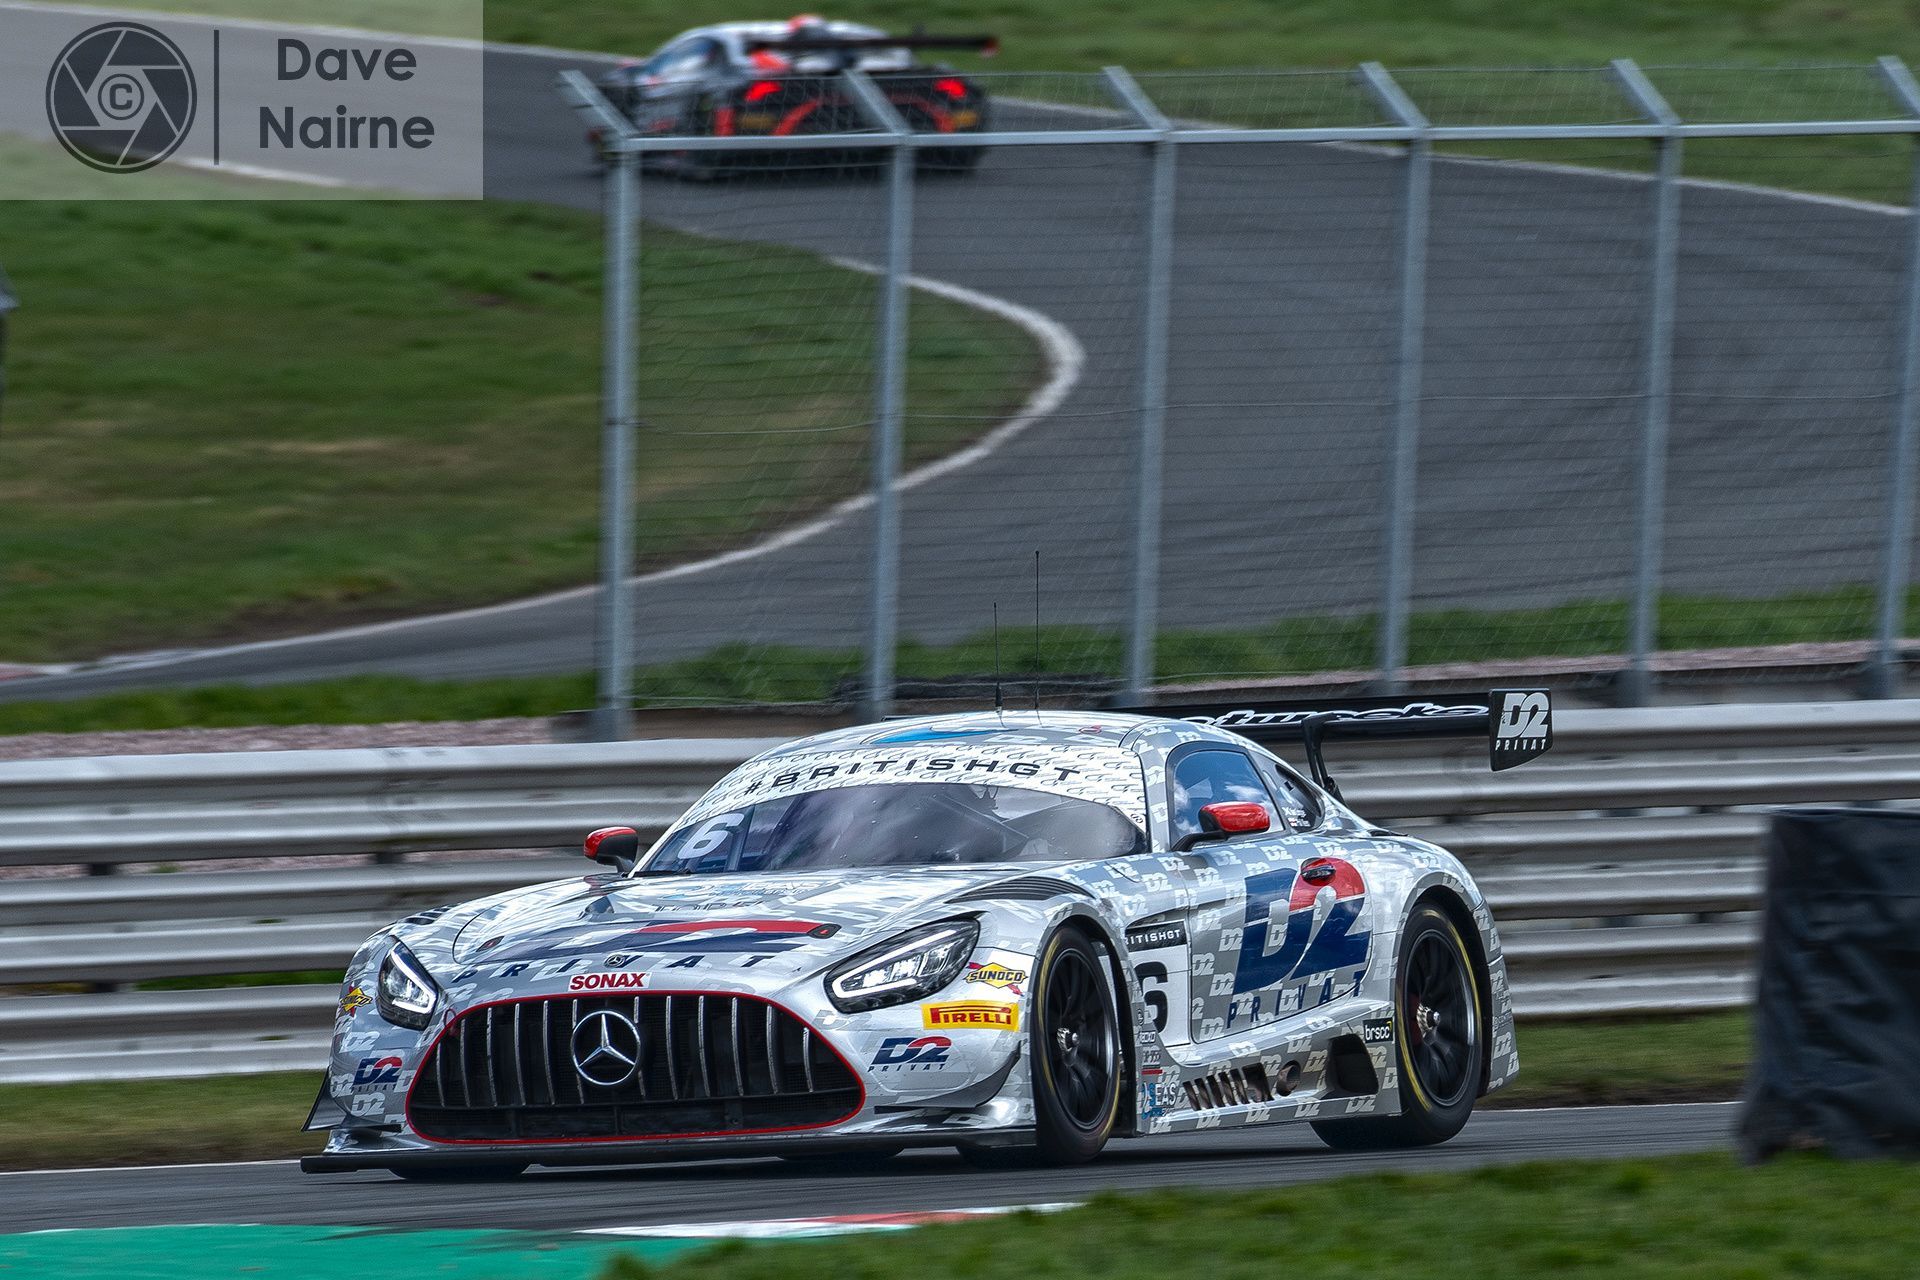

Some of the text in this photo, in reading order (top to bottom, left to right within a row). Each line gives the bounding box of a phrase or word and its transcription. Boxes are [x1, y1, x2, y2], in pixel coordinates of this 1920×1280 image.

[1497, 692, 1549, 738] D2
[1495, 739, 1546, 751] PRIVAT
[744, 758, 1080, 796] #BRITISHGT
[677, 813, 745, 860] 6
[1232, 857, 1373, 996] D2
[570, 973, 646, 990] SONAX
[969, 970, 1024, 983] SUNOCO
[929, 1005, 1012, 1025] PIRELLI
[339, 1031, 380, 1053] D2
[871, 1036, 952, 1065] D2
[352, 1056, 403, 1086] D2
[867, 1063, 946, 1072] PRIVAT
[350, 1093, 386, 1117] D2
